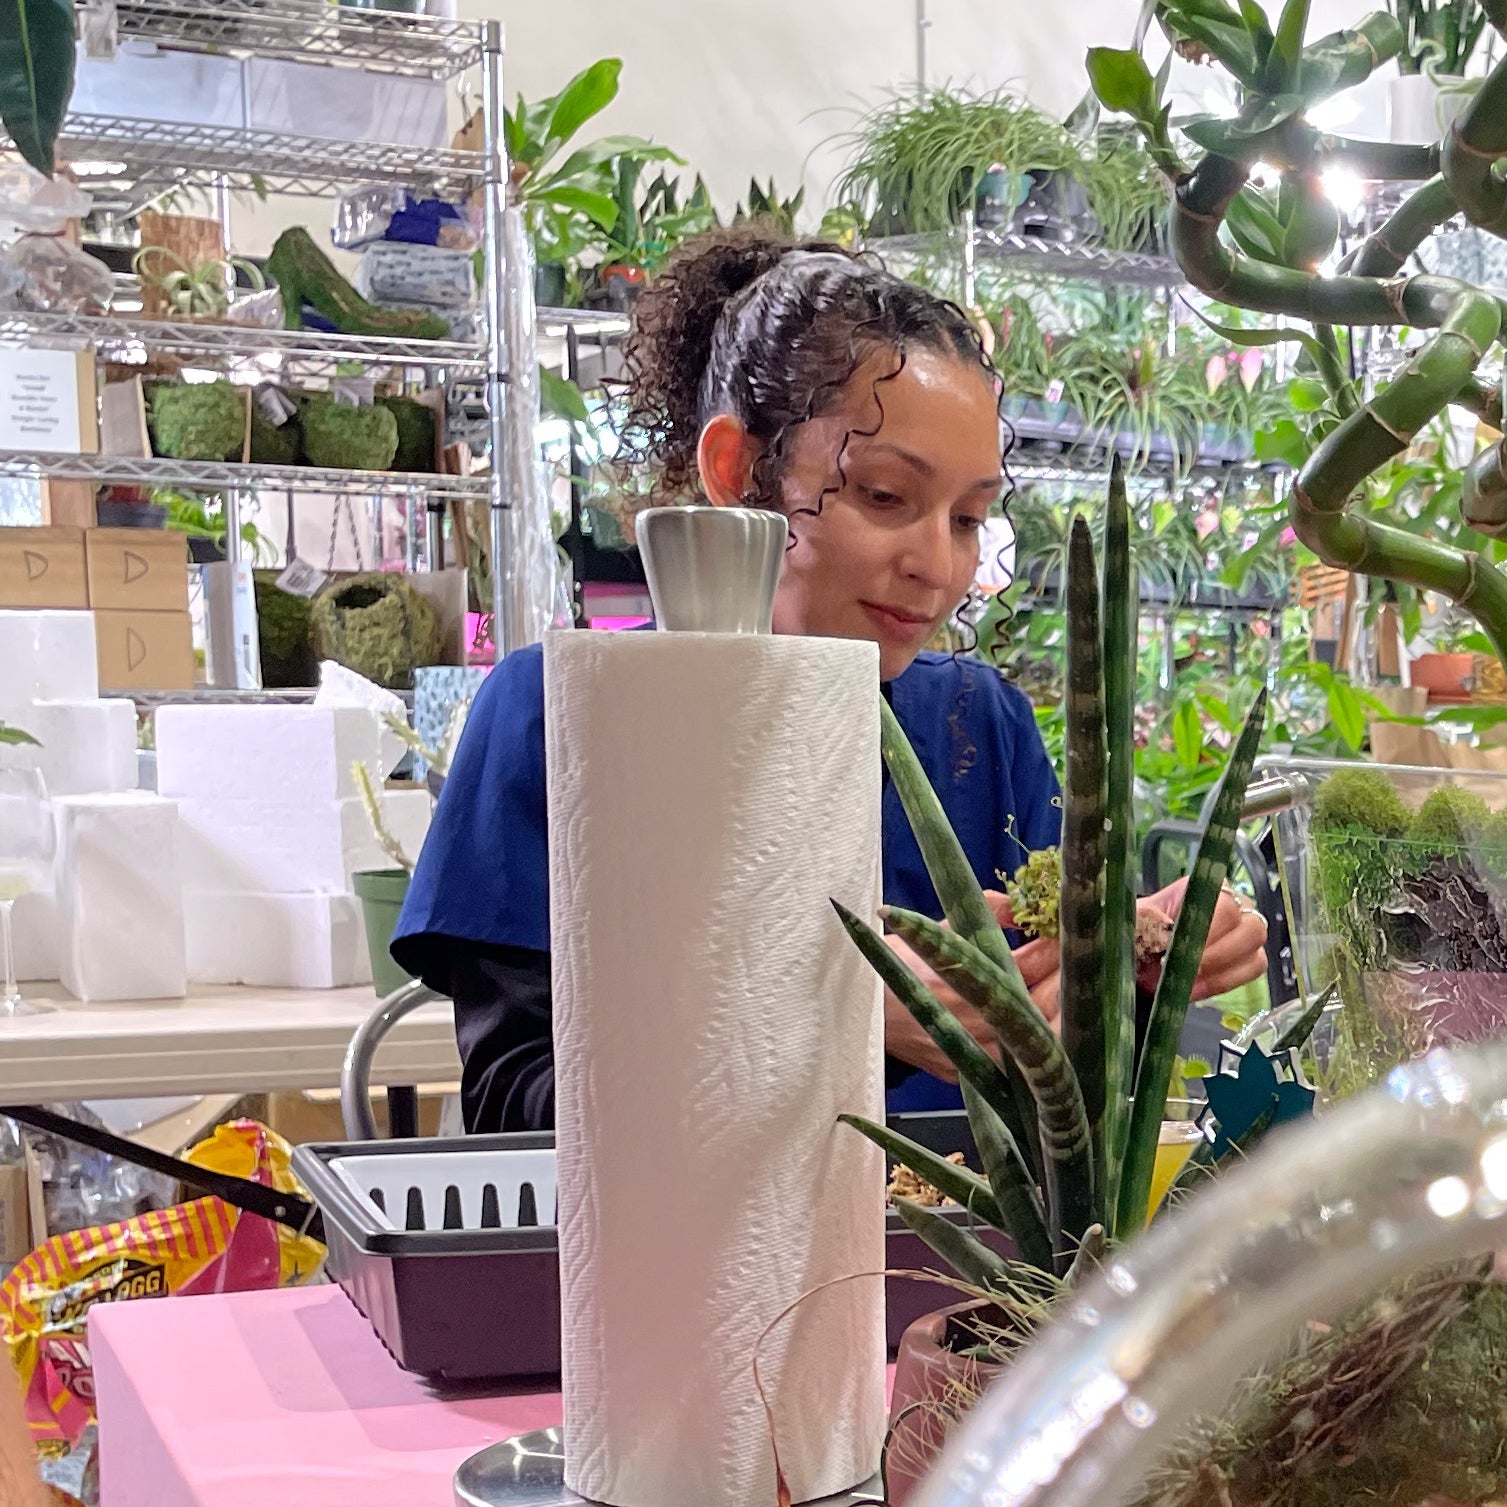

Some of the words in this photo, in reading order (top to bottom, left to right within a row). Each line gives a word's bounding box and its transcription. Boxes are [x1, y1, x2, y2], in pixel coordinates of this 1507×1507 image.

[23, 549, 49, 581] D
[123, 550, 149, 584] D
[126, 626, 147, 673] D
